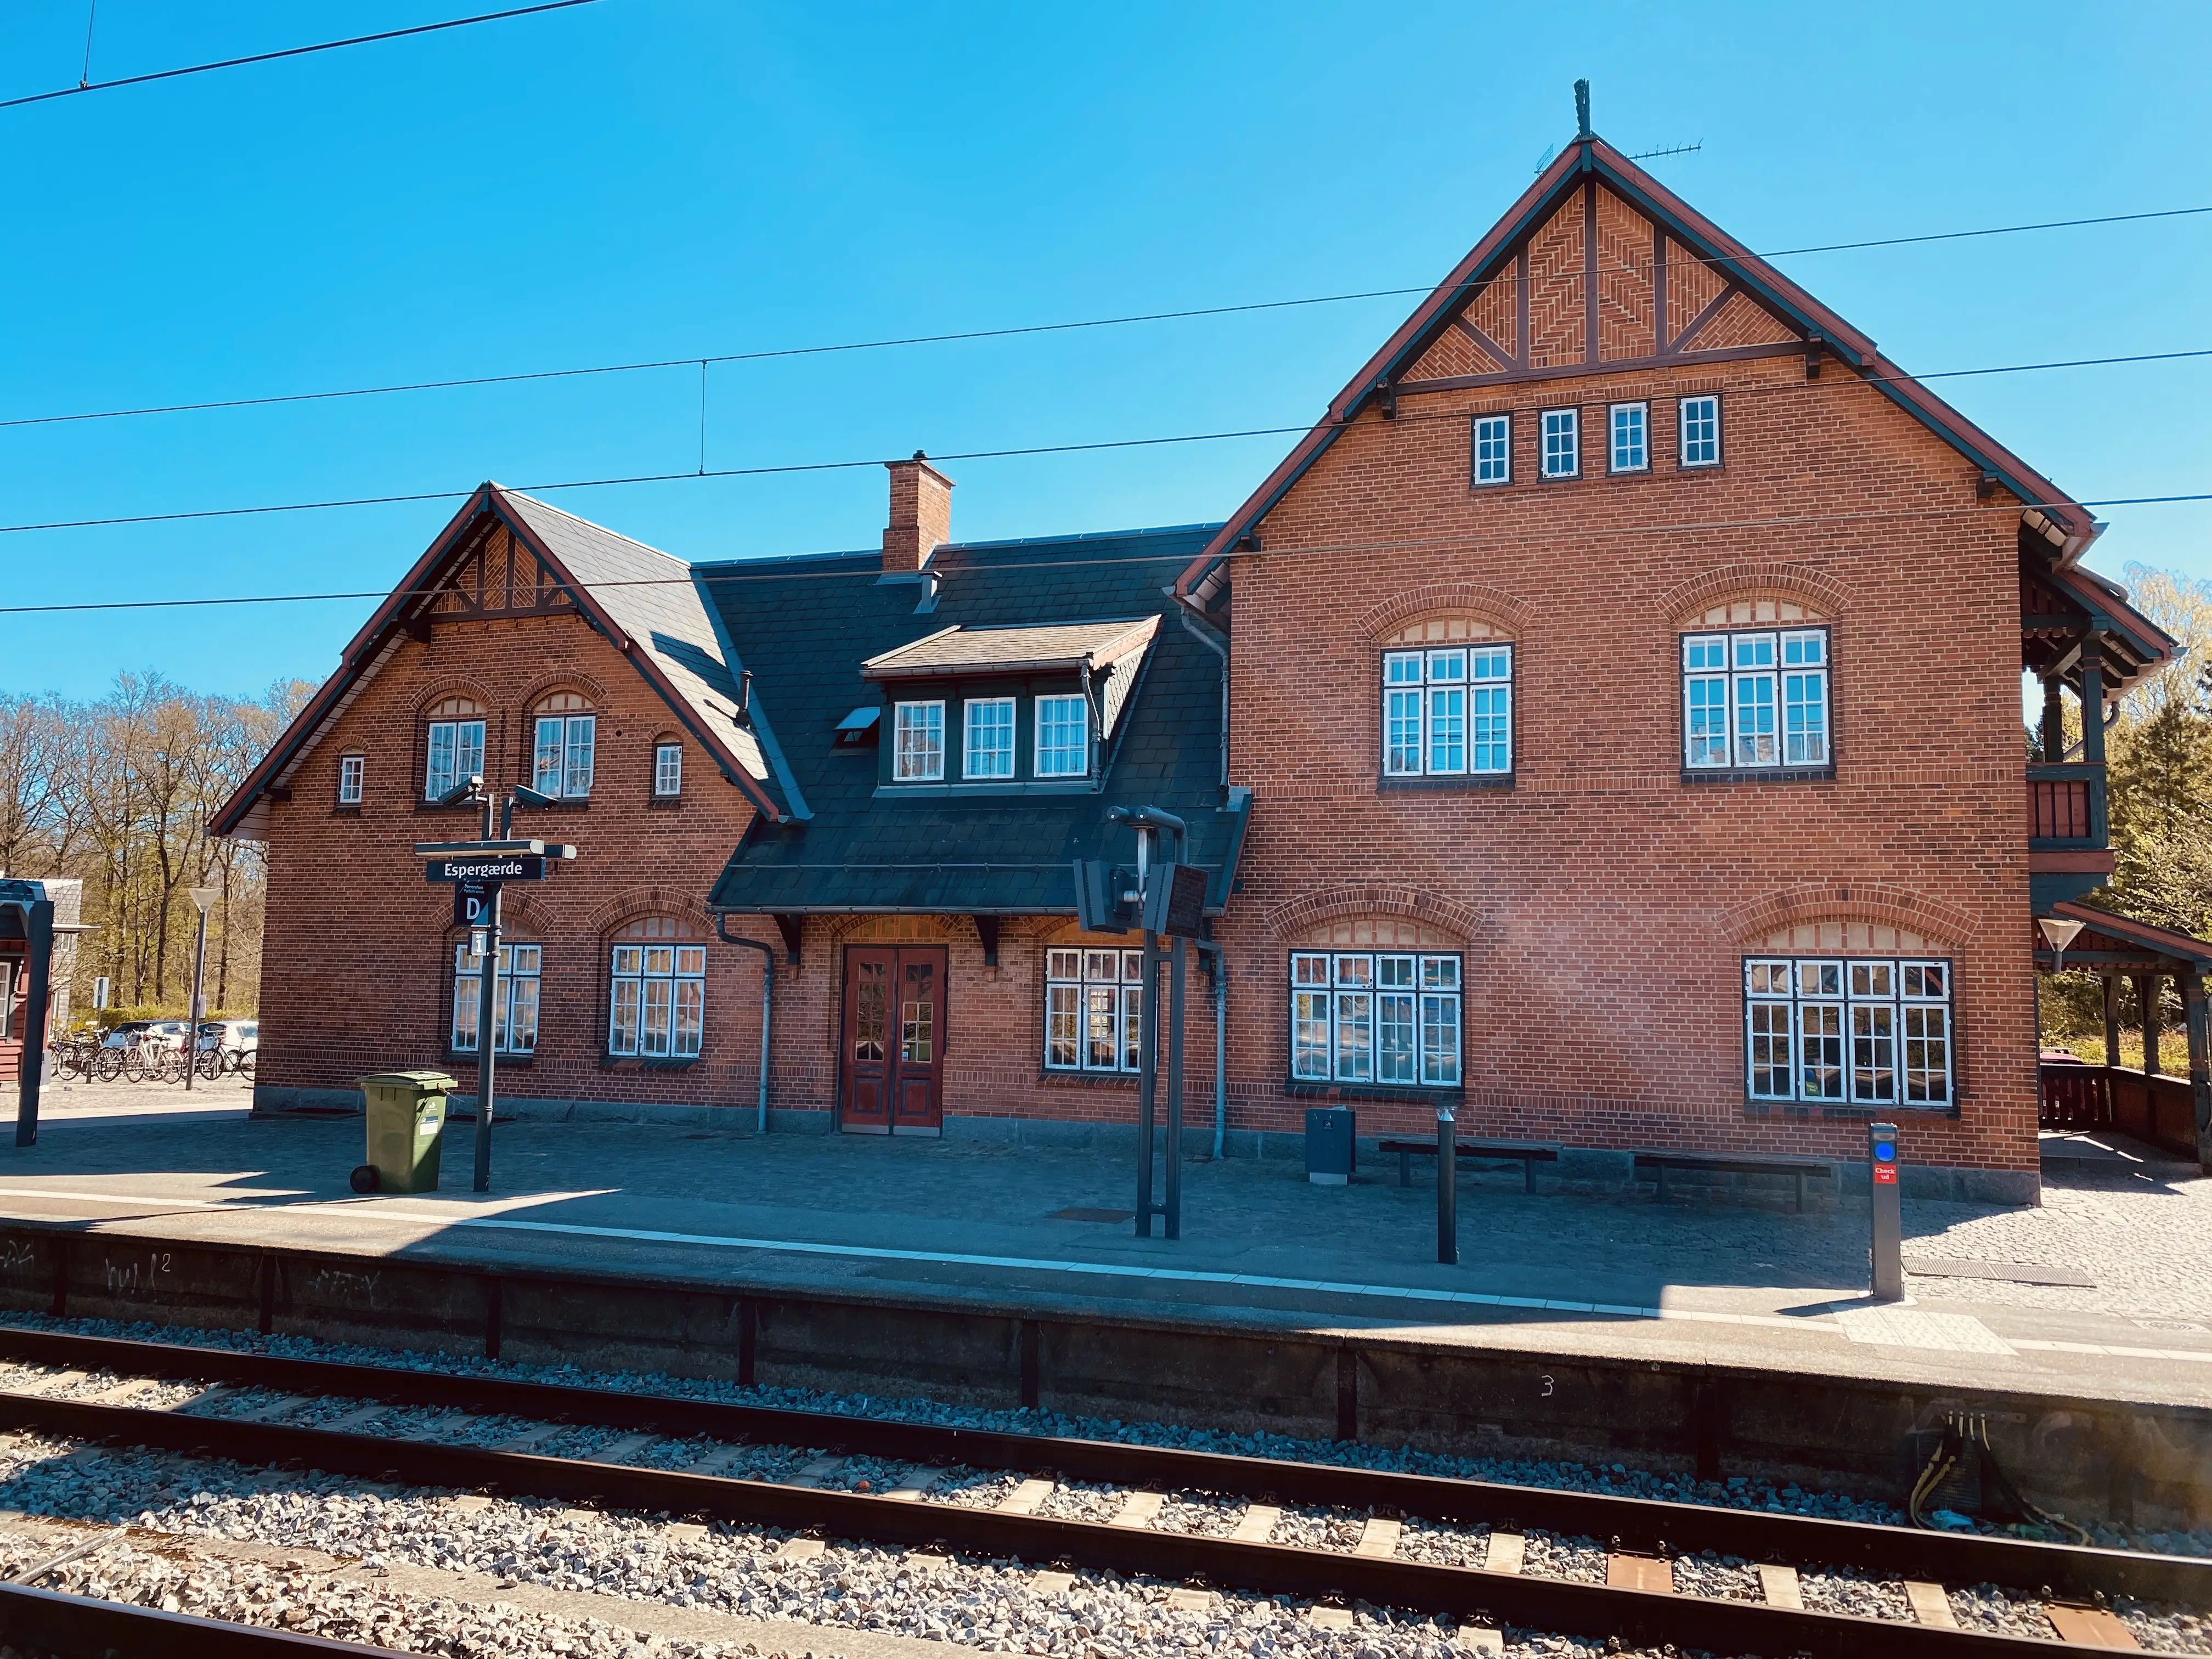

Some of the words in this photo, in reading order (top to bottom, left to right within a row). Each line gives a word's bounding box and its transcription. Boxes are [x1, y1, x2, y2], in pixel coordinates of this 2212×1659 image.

[444, 861, 522, 879] Espergærde
[467, 898, 480, 919] D
[161, 1253, 171, 1272] 2
[1541, 1374, 1554, 1397] 3
